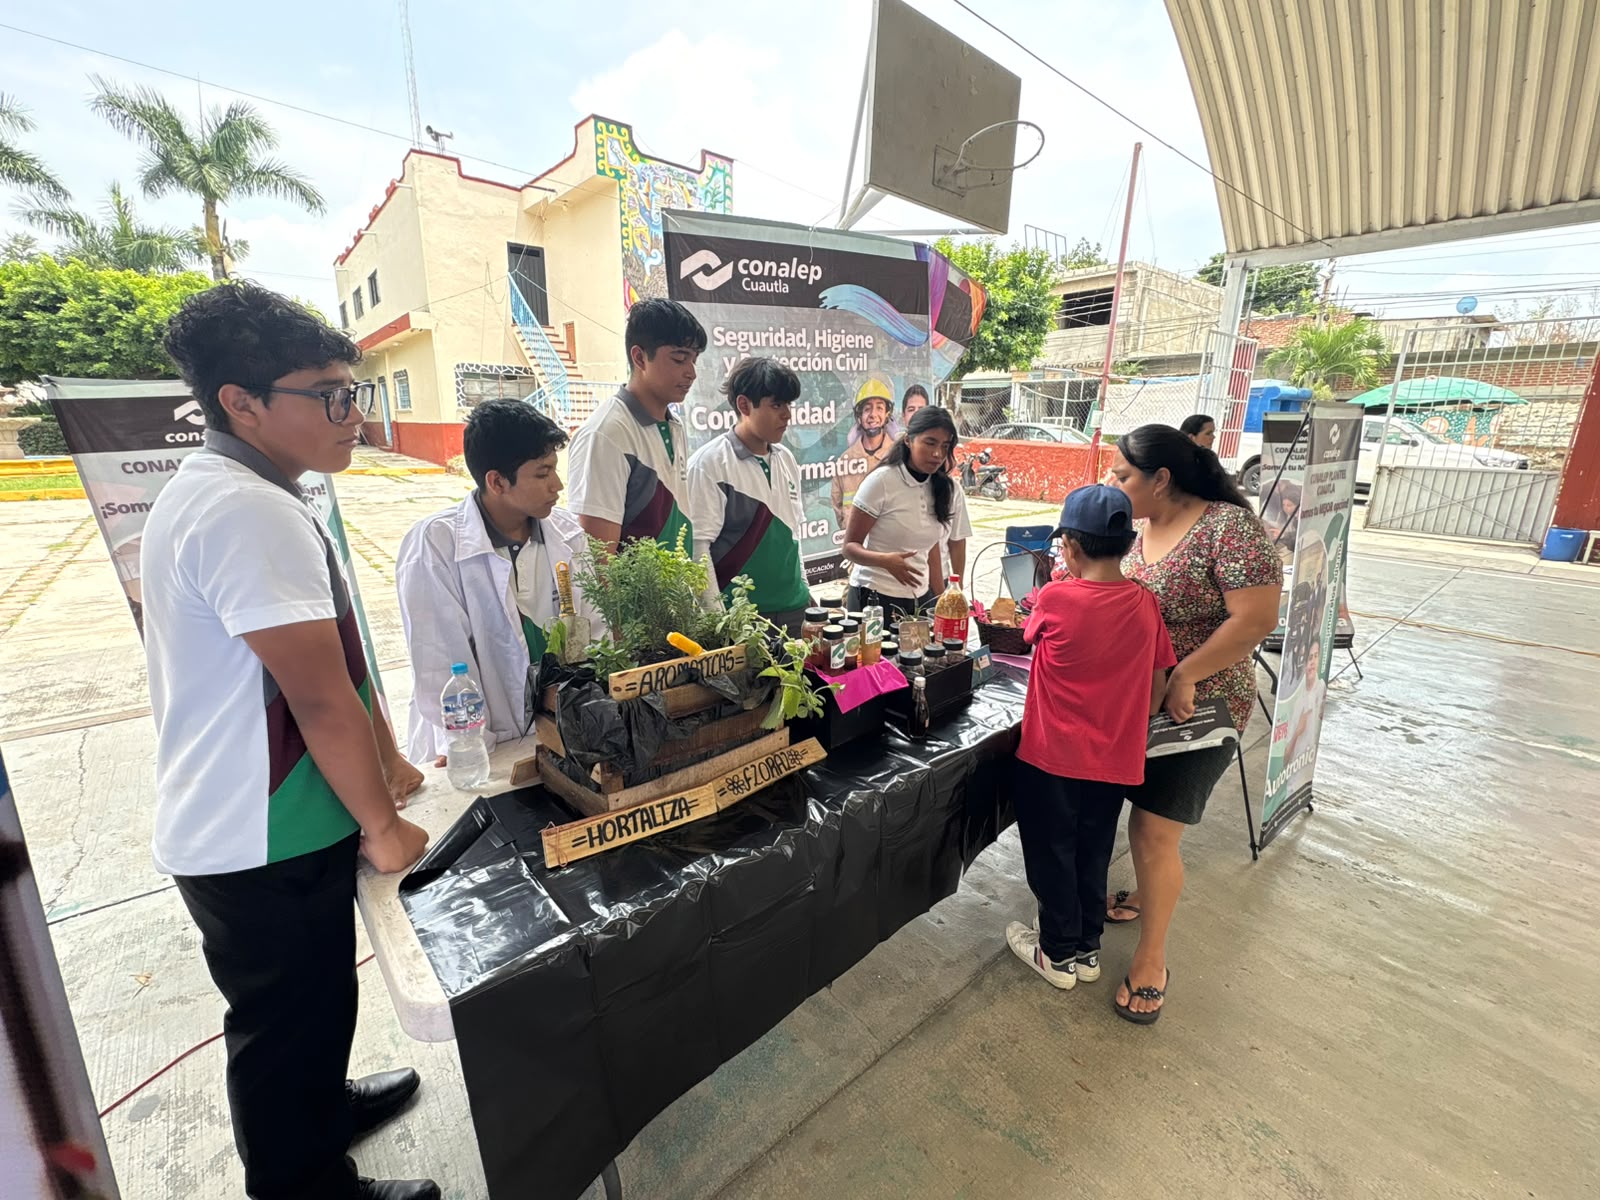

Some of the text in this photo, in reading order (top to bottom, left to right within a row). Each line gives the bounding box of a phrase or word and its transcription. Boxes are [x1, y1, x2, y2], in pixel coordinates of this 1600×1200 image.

[738, 257, 822, 285] conalep
[742, 277, 789, 293] Cuautla
[713, 326, 874, 353] Seguridad, Higiene
[723, 354, 736, 378] y
[835, 353, 868, 371] Civil
[691, 399, 836, 431] Conidad
[121, 458, 182, 475] CONA
[100, 500, 155, 519] ¡Som
[805, 562, 835, 575] DUCACIÓN
